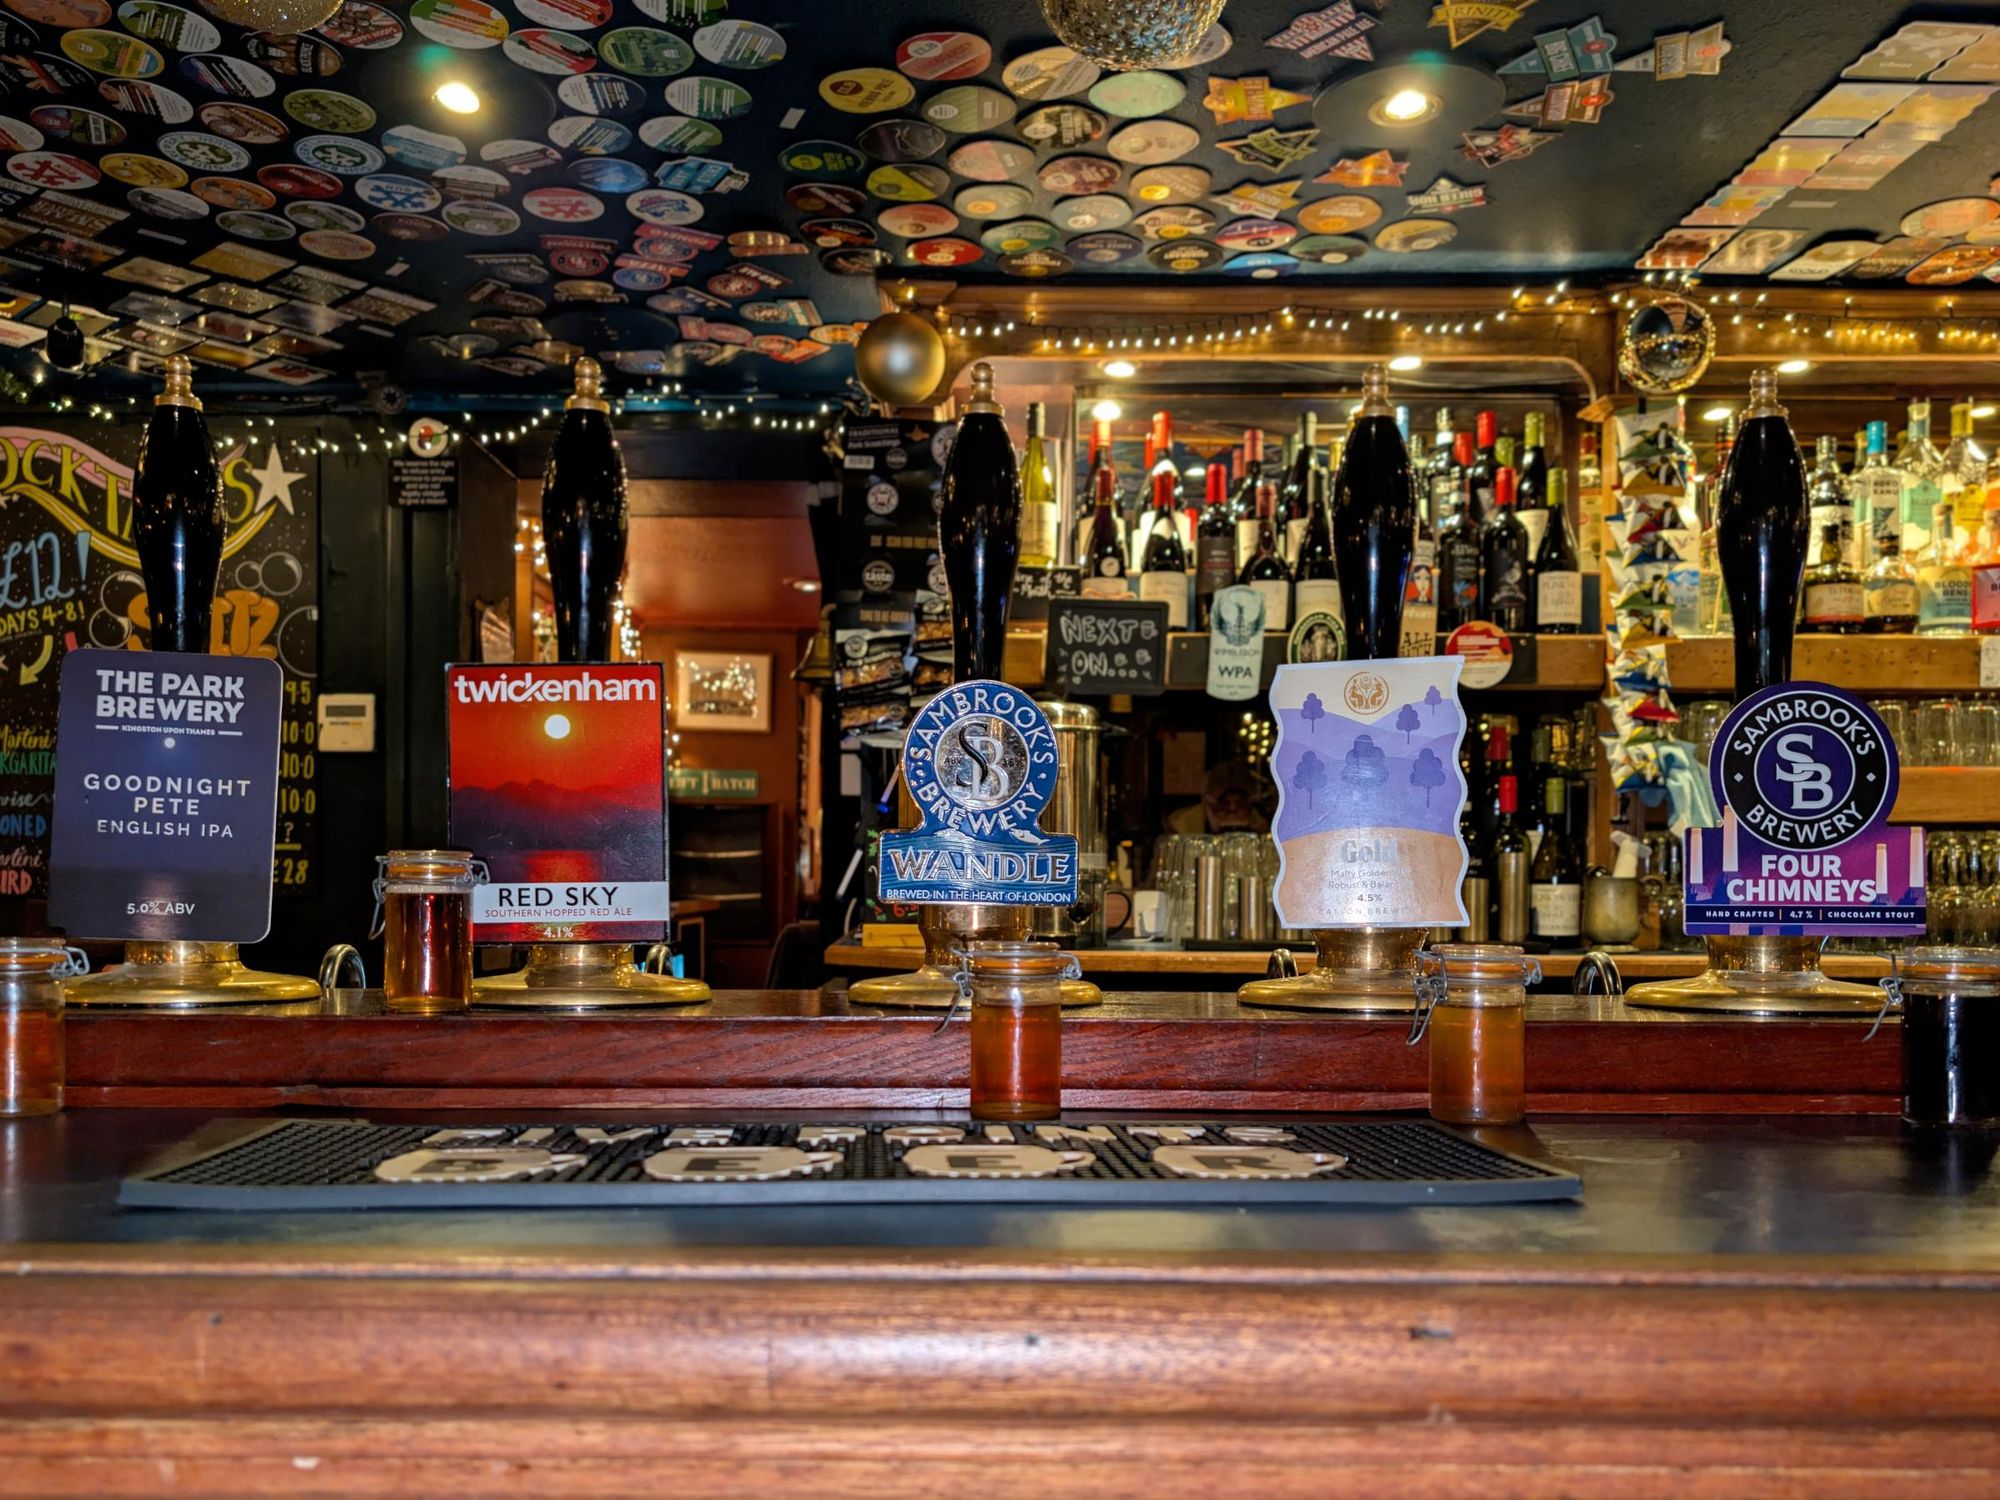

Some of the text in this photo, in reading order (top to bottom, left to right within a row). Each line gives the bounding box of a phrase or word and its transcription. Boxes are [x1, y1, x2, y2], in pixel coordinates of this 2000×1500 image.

[1059, 614, 1139, 647] NEXT
[96, 669, 245, 699] THE PARK
[1218, 665, 1254, 680] WPA
[454, 671, 656, 703] twickenham
[96, 695, 245, 724] BREWERY
[121, 724, 216, 736] KINGSTON UPON THAMES
[910, 688, 1054, 765] SAMBROOK'S
[1734, 699, 1876, 757] SAMBROOK'S
[83, 772, 252, 797] GOODNIGHT
[134, 797, 201, 816] PETE
[917, 781, 1044, 835] BREWERY
[97, 819, 234, 839] ENGLISH IPA
[1746, 801, 1864, 844] BREWERY
[1340, 838, 1398, 865] Gold
[888, 846, 1073, 885] WANDLE
[1761, 854, 1841, 878] FOUR
[498, 886, 619, 907] RED SKY
[886, 888, 1071, 903] BREWED IN THE HEART OF LONDON
[1357, 893, 1384, 902] 4.5%
[1726, 878, 1877, 903] CHIMNEYS
[127, 900, 196, 916] 5.0% ABV
[485, 907, 633, 918] SOUTHERN HOPPED RED ALE
[1705, 910, 1730, 918] HAND
[1733, 910, 1775, 919] CRAFTED
[1827, 911, 1882, 919] CHOCOLATE
[1885, 911, 1915, 919] STOUT
[543, 926, 574, 939] 4.1%
